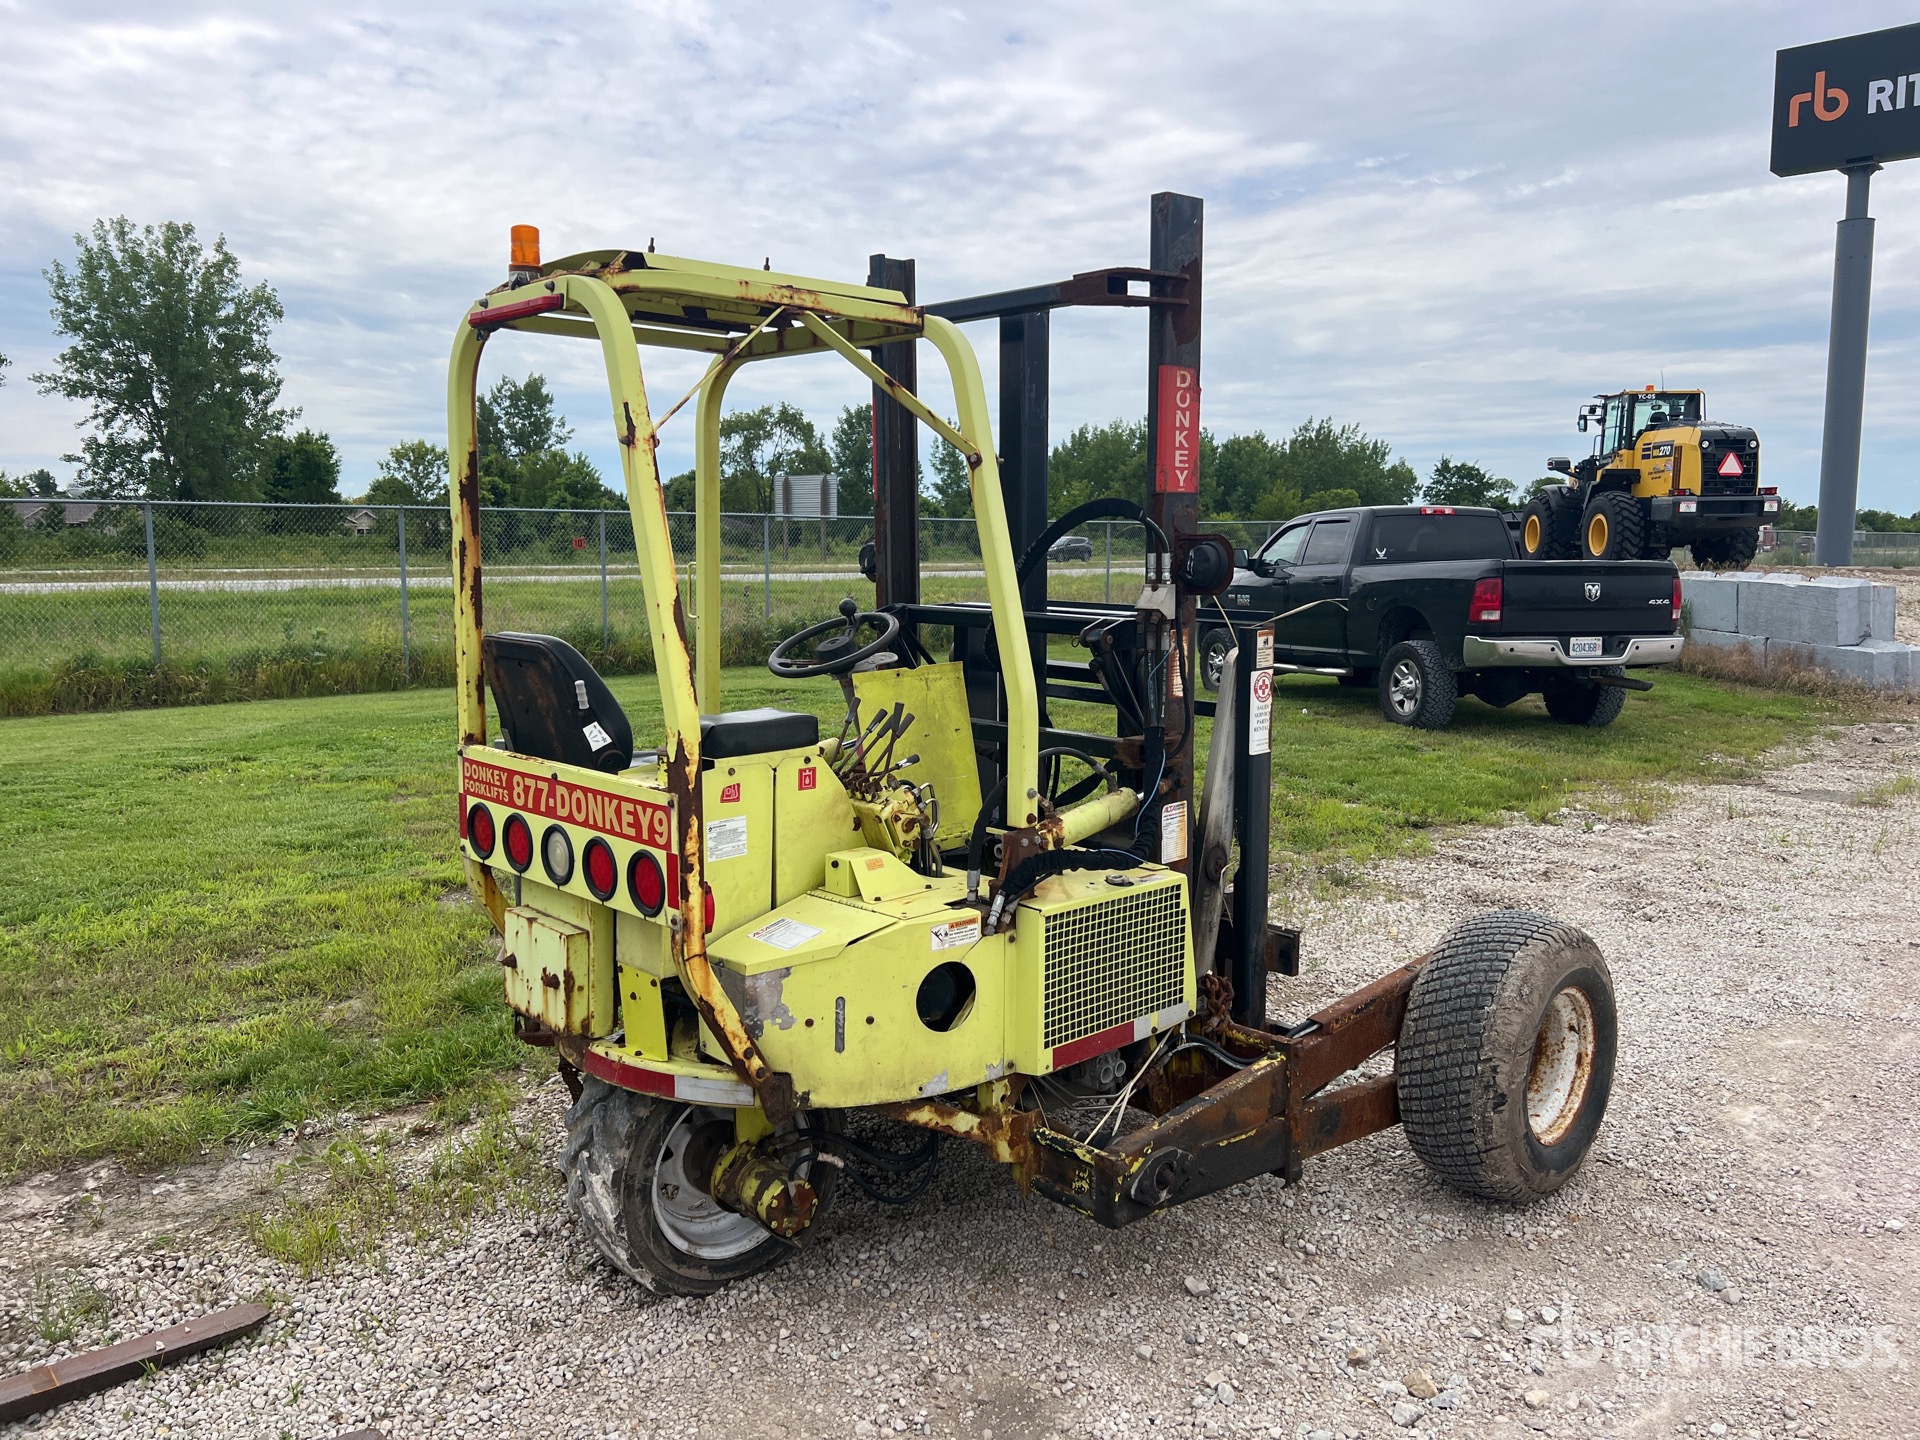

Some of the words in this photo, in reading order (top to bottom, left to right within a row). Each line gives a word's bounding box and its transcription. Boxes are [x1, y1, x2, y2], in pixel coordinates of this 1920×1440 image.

[1174, 370, 1191, 487] DONKEY
[464, 761, 508, 787] DONKEY
[464, 778, 509, 803] FORKLIFTS
[512, 774, 669, 846] 877-DONKEY9
